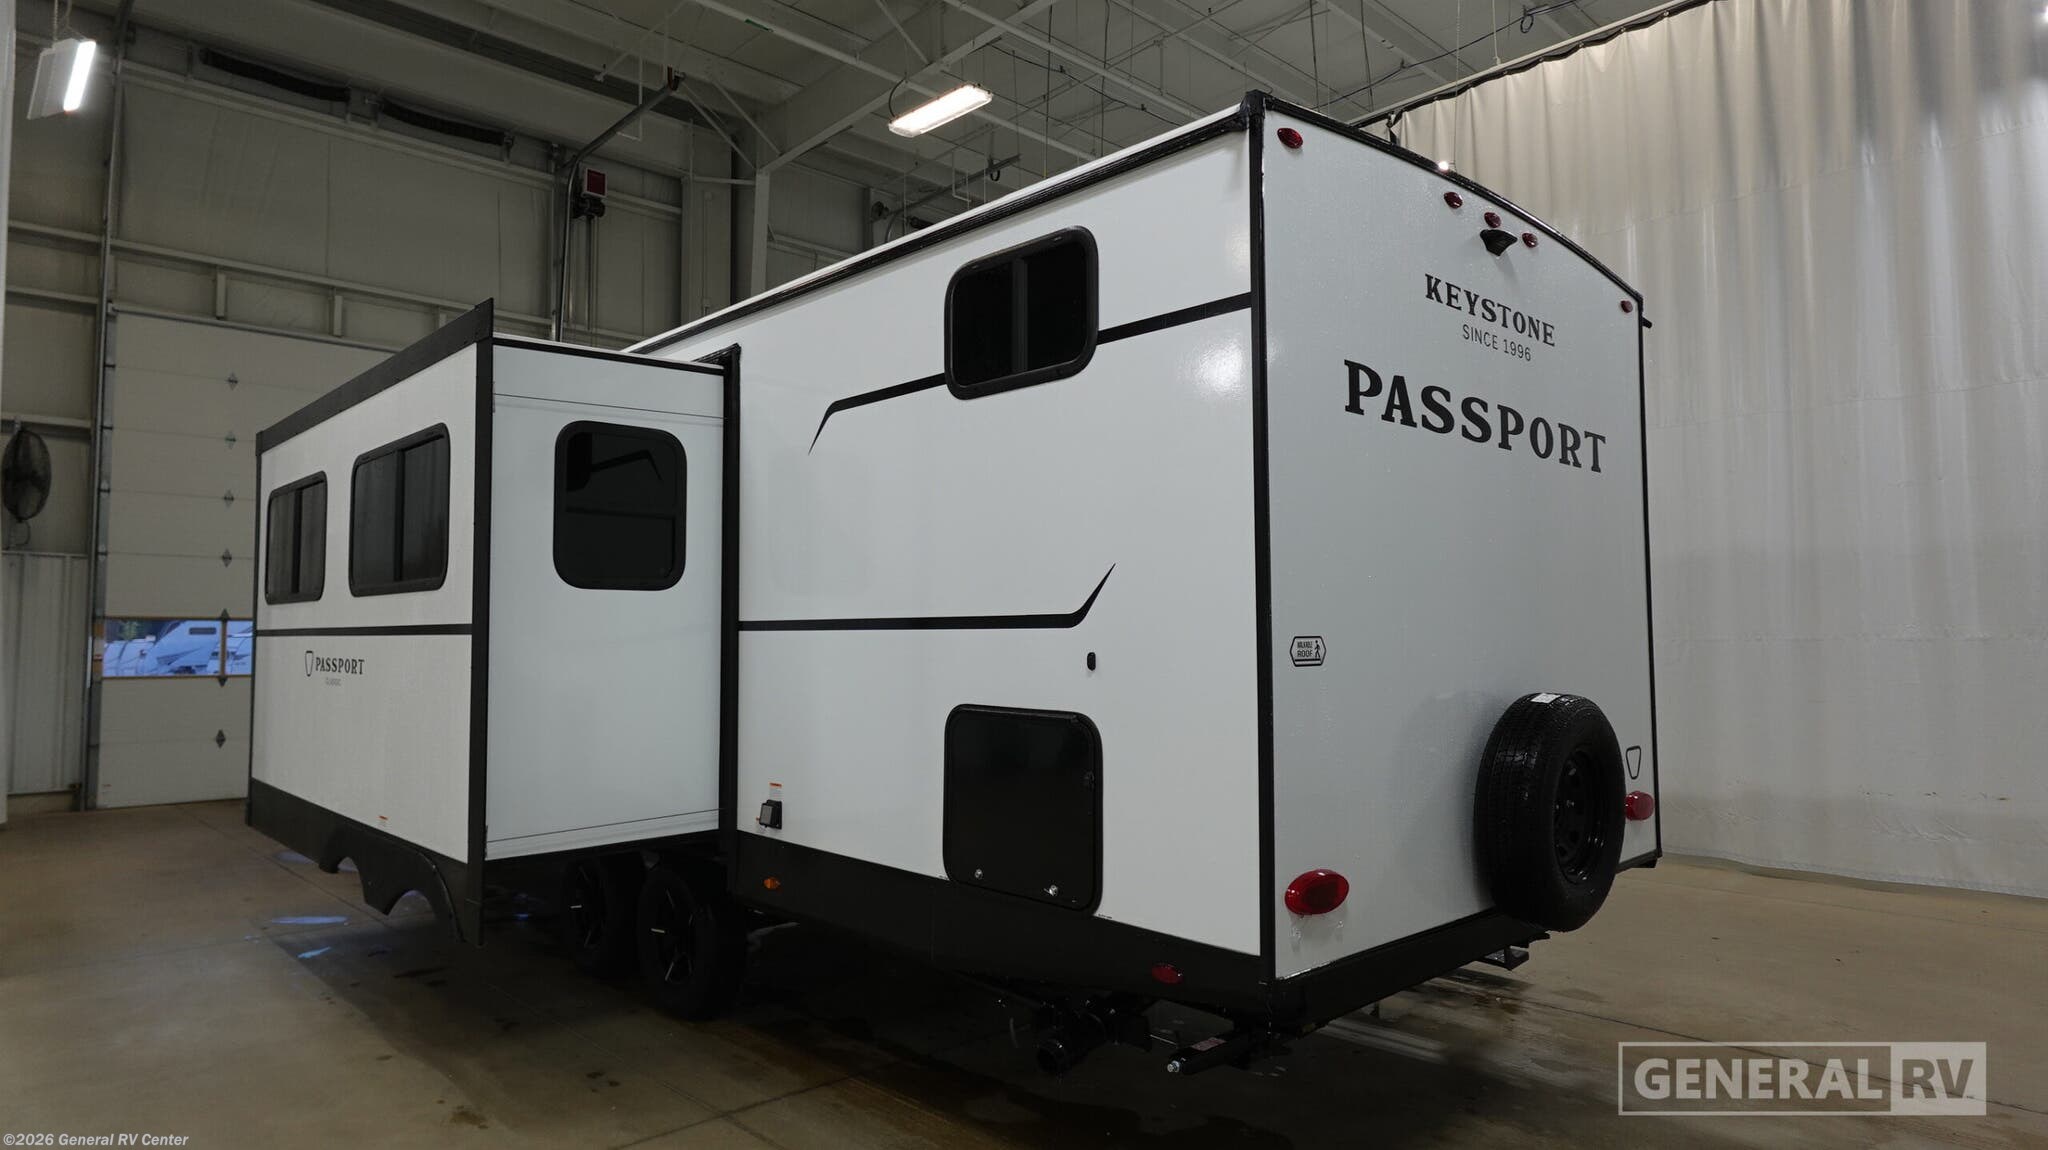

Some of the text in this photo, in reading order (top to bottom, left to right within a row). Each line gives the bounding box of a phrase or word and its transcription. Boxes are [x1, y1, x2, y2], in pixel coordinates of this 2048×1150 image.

[1424, 273, 1555, 347] KEYSTONE
[1462, 324, 1531, 361] SINCE 1996
[1344, 359, 1606, 473] PASSPORT
[315, 656, 365, 675] PASSPORT
[1297, 650, 1313, 658] ROOF
